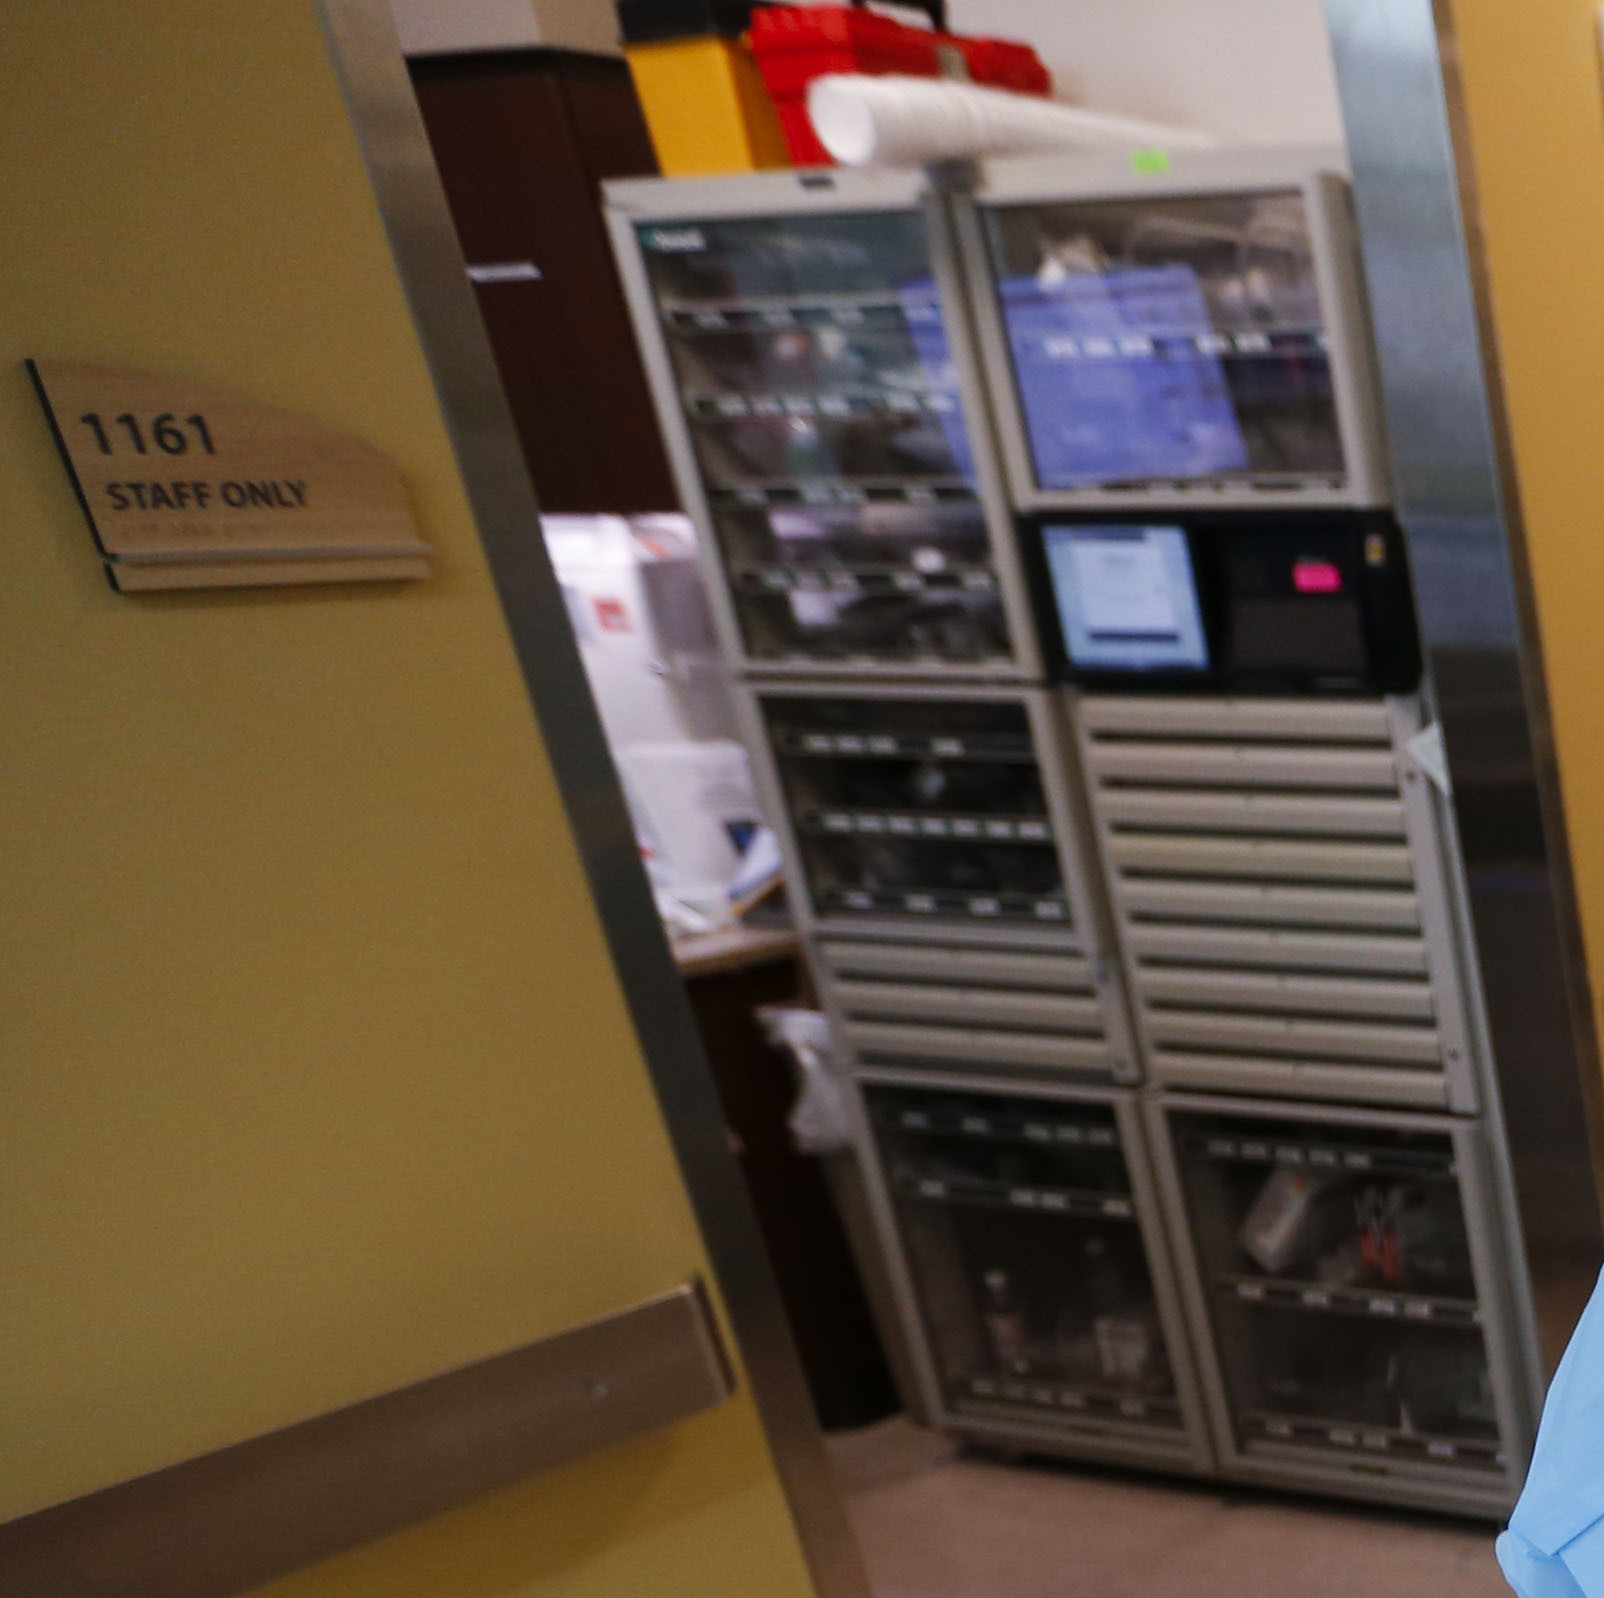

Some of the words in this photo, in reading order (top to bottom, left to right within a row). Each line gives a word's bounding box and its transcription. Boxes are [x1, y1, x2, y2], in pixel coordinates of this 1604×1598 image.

[80, 413, 216, 455] 1161
[106, 481, 211, 510] STAFF
[220, 480, 307, 509] ONLY
